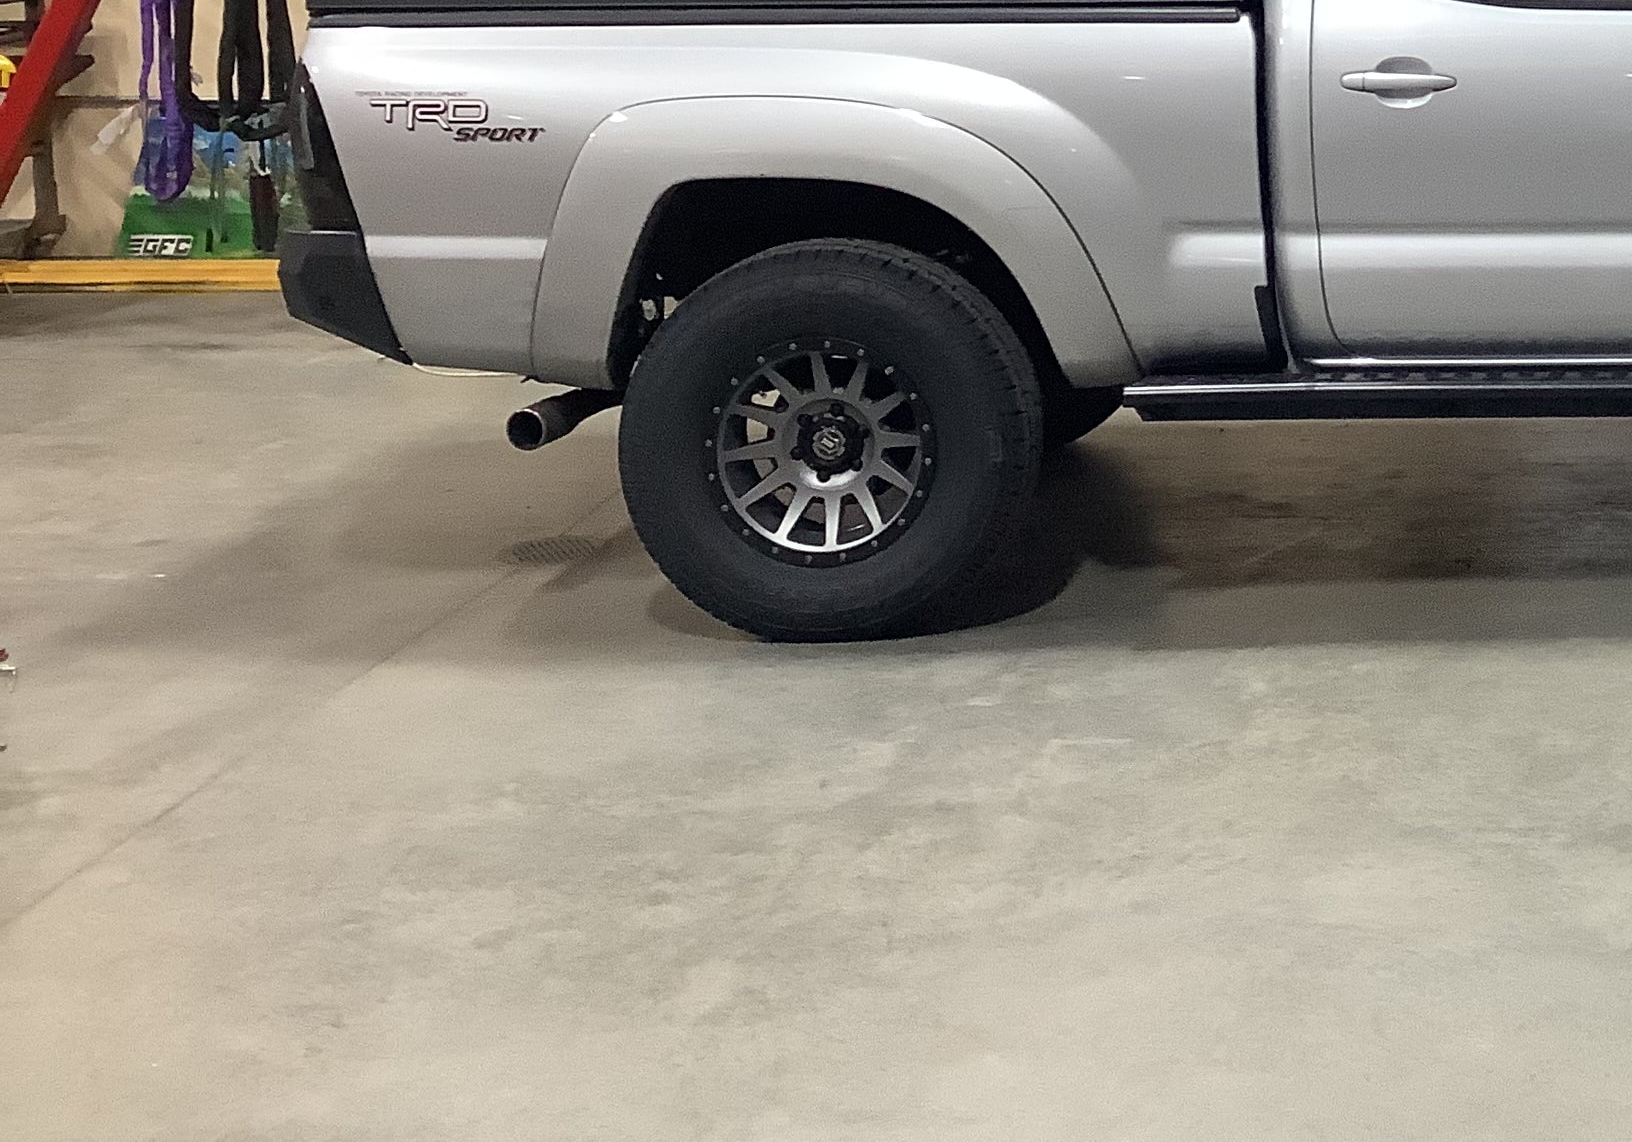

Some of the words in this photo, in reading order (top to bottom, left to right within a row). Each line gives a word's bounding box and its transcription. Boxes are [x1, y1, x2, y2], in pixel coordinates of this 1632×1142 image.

[369, 98, 489, 132] TRD
[452, 127, 546, 143] SPORT
[141, 234, 193, 257] GFC
